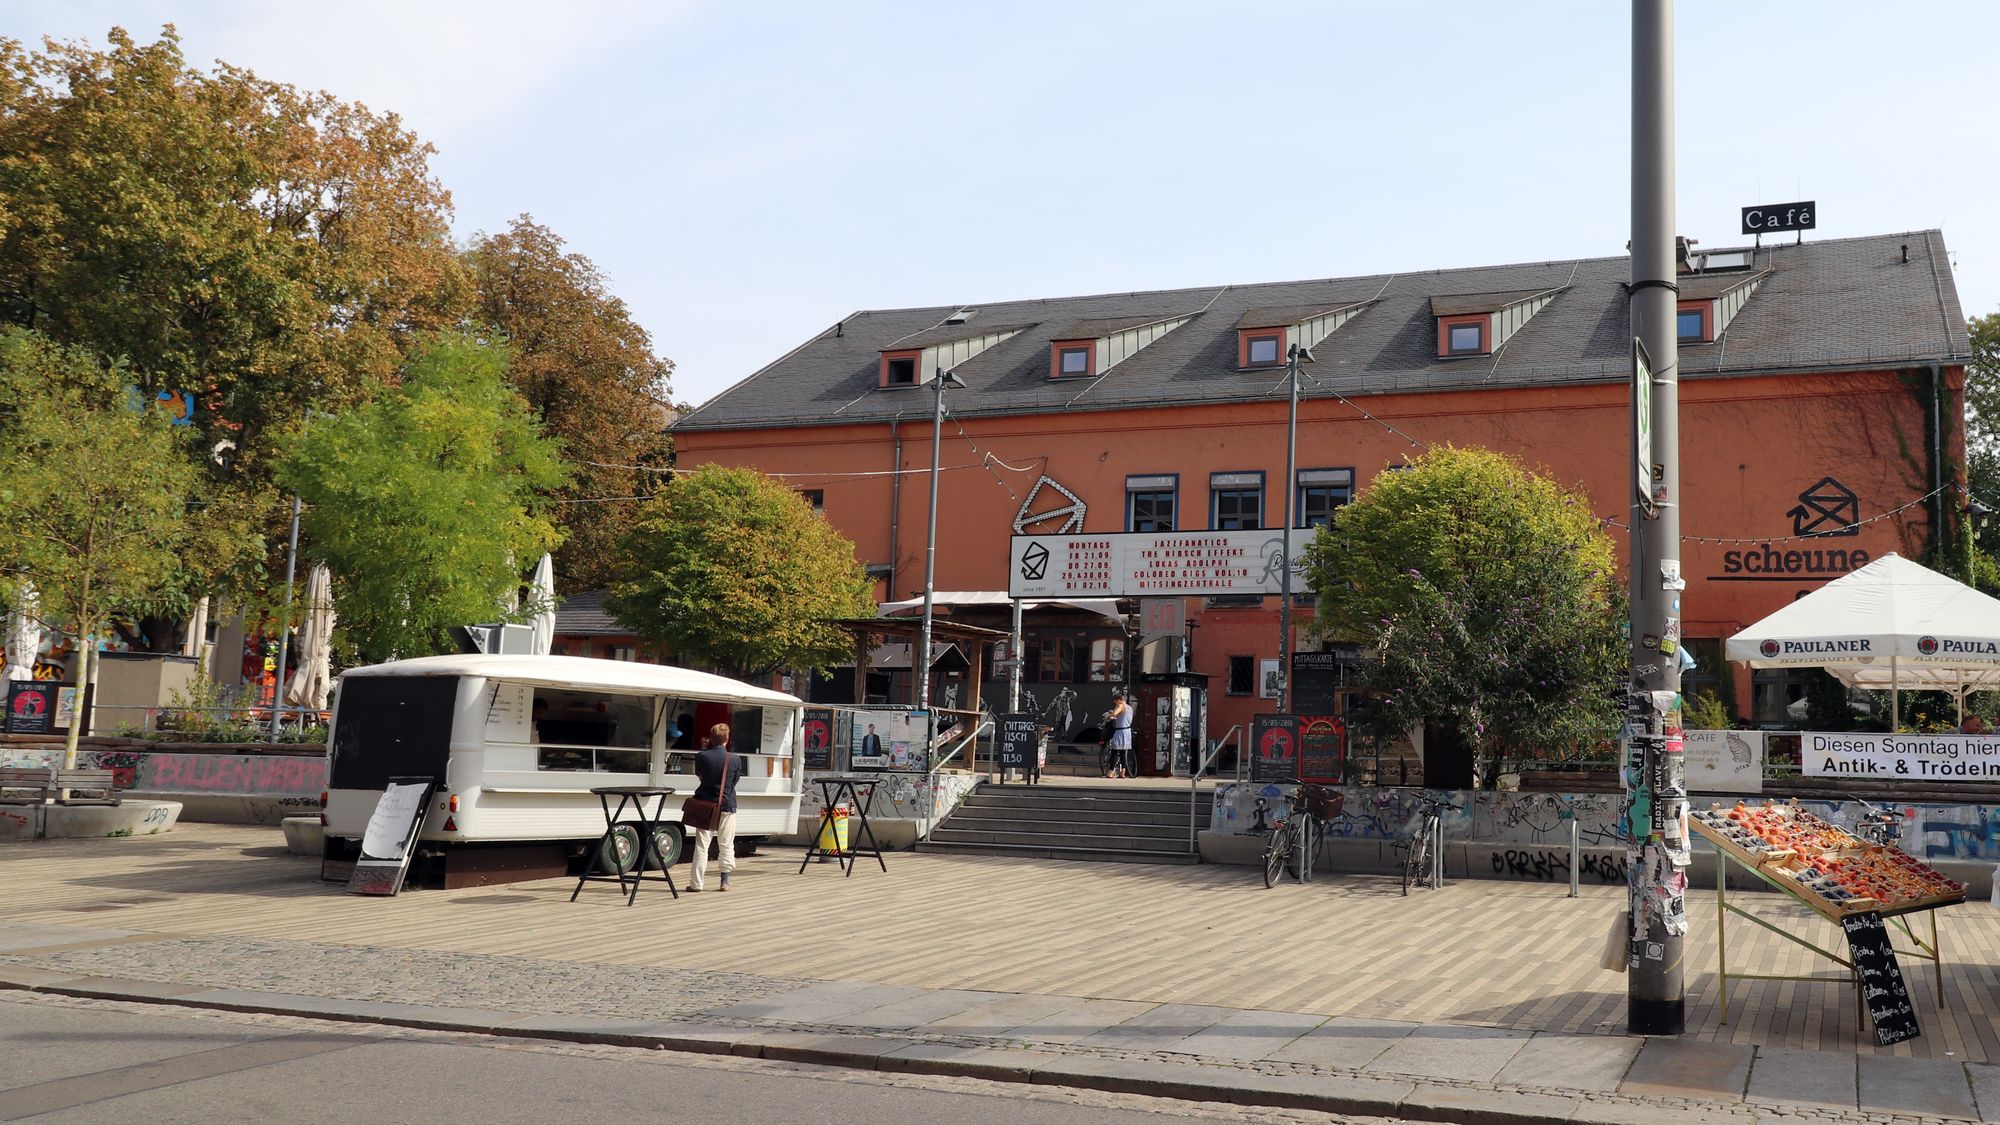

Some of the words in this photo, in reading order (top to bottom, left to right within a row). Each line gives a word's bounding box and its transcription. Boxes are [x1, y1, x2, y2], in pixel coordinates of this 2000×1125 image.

[1745, 208, 1811, 229] Café
[1154, 539, 1228, 547] JAZZFANATICS
[1165, 549, 1201, 557] HIRSCH
[1208, 548, 1244, 557] EFFEKT
[1149, 560, 1178, 568] LUKAS
[1186, 559, 1229, 567] ADOLPHI
[1724, 544, 1869, 574] scheune
[1215, 569, 1248, 577] VOL.10
[1139, 580, 1233, 588] MITSINGZENTRALE
[1784, 639, 1871, 654] PAULANER
[1943, 640, 2000, 655] PAULA
[1294, 654, 1334, 664] MITTAGSKARTE
[1004, 721, 1035, 731] MITTAGS
[1004, 732, 1027, 742] TISCH
[1003, 743, 1014, 752] AB
[1813, 737, 1875, 752] Diesen
[1882, 739, 1959, 758] Sonntag
[1966, 740, 2000, 755] hier
[1003, 754, 1022, 763] 11.30
[1823, 758, 1886, 773] Antik-
[1896, 760, 1909, 774] &
